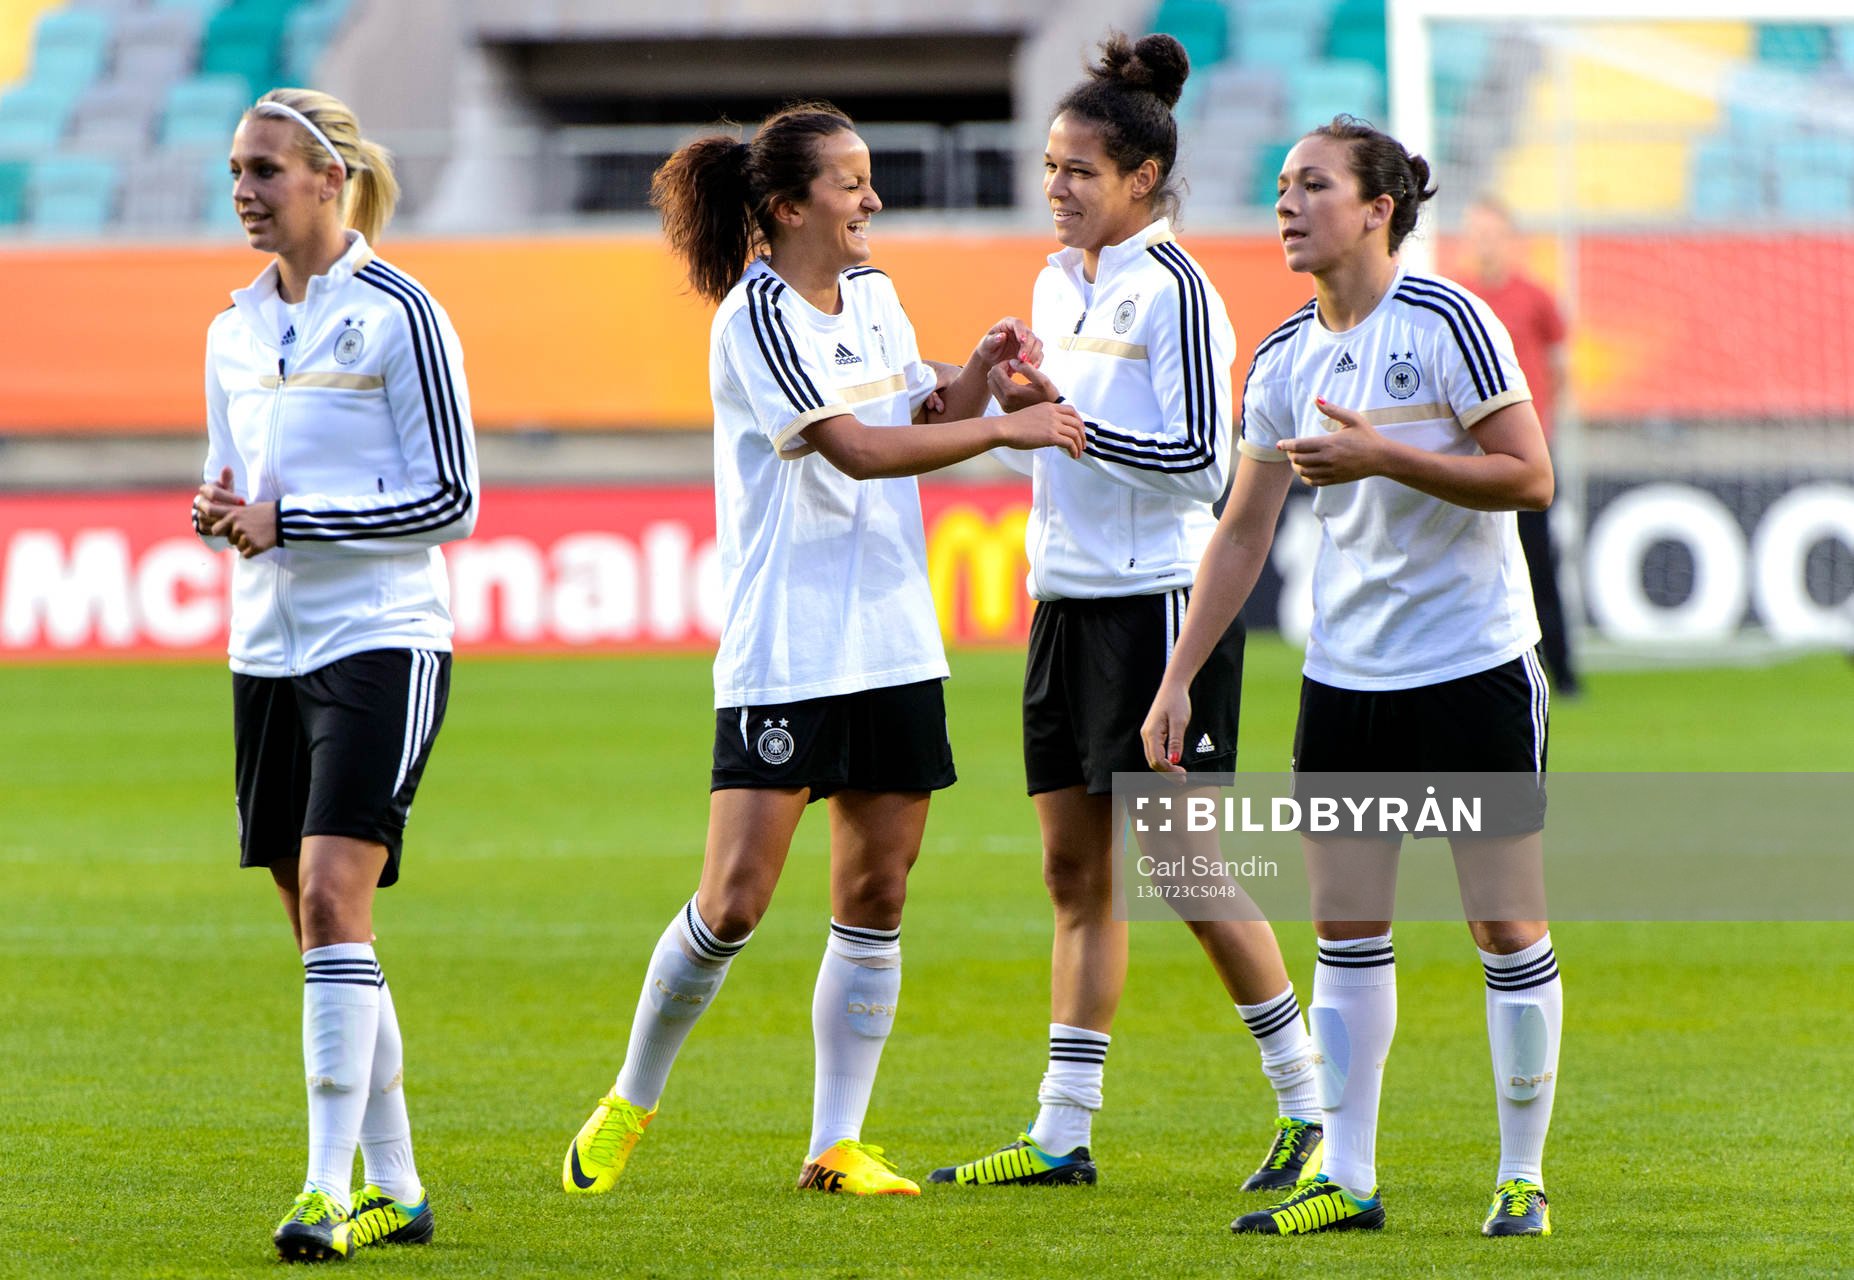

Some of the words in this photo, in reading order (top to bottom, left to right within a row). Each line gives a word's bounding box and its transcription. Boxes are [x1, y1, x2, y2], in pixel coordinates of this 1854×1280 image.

[1334, 363, 1357, 374] adidas
[956, 1146, 1034, 1186] PUMA
[1271, 1189, 1349, 1236] PUMA
